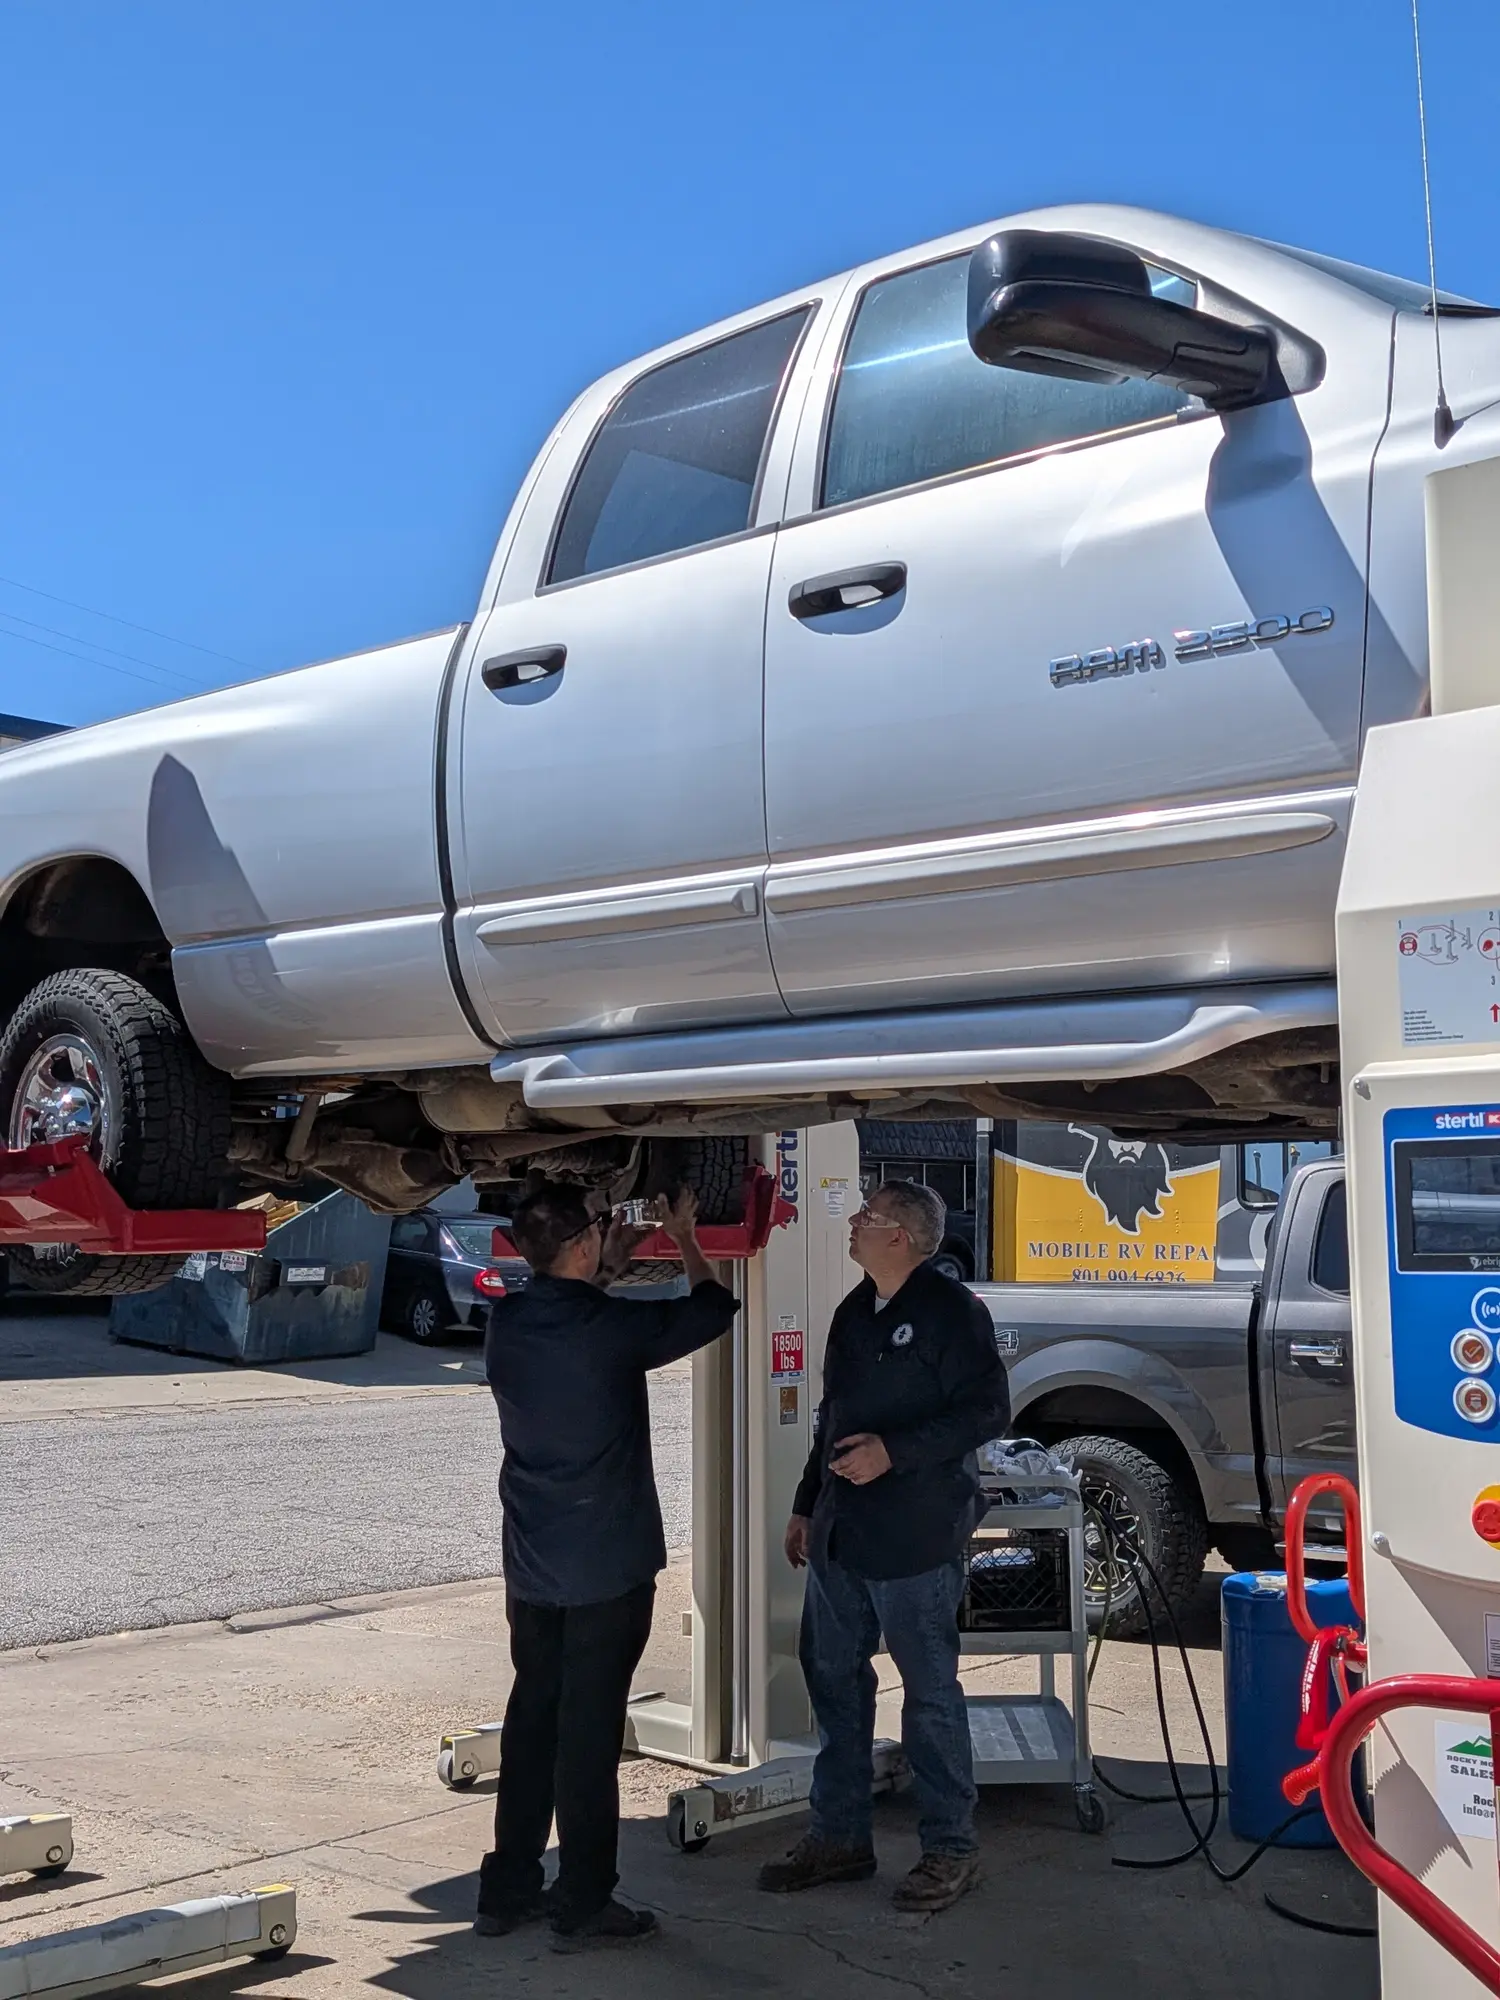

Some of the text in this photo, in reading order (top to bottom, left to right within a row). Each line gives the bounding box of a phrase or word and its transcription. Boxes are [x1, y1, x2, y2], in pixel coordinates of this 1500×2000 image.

[1049, 605, 1335, 684] RAM 2500
[1435, 1111, 1485, 1129] stertil
[1028, 1242, 1109, 1259] MOBILE
[1118, 1243, 1146, 1260] RV
[774, 1334, 802, 1352] 18500
[780, 1352, 795, 1370] lbs
[1446, 1754, 1478, 1766] ROCKY
